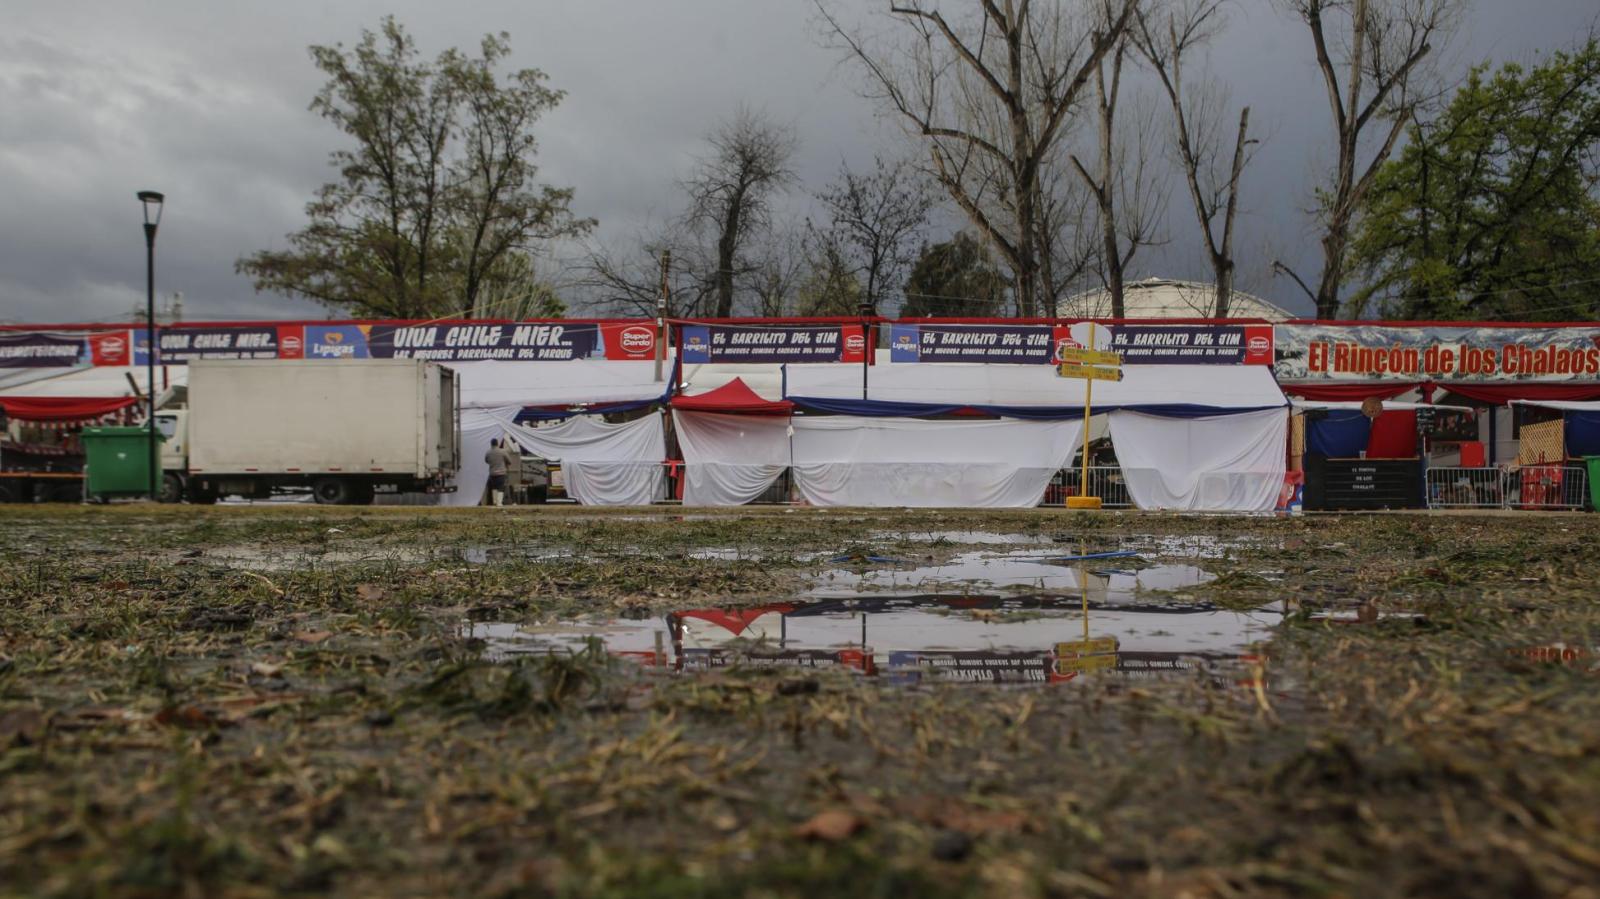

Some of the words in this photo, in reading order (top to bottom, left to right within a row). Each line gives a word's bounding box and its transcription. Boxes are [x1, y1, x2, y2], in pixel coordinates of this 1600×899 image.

[445, 325, 502, 347] CHILE
[623, 332, 653, 342] Super
[713, 332, 726, 345] EL
[731, 331, 787, 345] BARRILITO
[791, 332, 811, 344] DEL
[815, 332, 839, 344] JIM
[922, 333, 936, 345] EL
[941, 333, 998, 345] BARRILITO
[1002, 333, 1022, 346] DEL
[1027, 334, 1050, 346] JIM
[1115, 333, 1128, 345] EL
[1134, 333, 1190, 346] BARRILITO
[1194, 334, 1214, 346] DEL
[1218, 333, 1241, 346] JIM
[313, 343, 355, 357] Lipigas
[623, 340, 653, 352] Cerdo
[1308, 342, 1329, 373] El
[1334, 342, 1419, 375] Rincón
[1424, 345, 1455, 375] de
[1459, 344, 1496, 375] los
[1501, 344, 1599, 375] Chalaos
